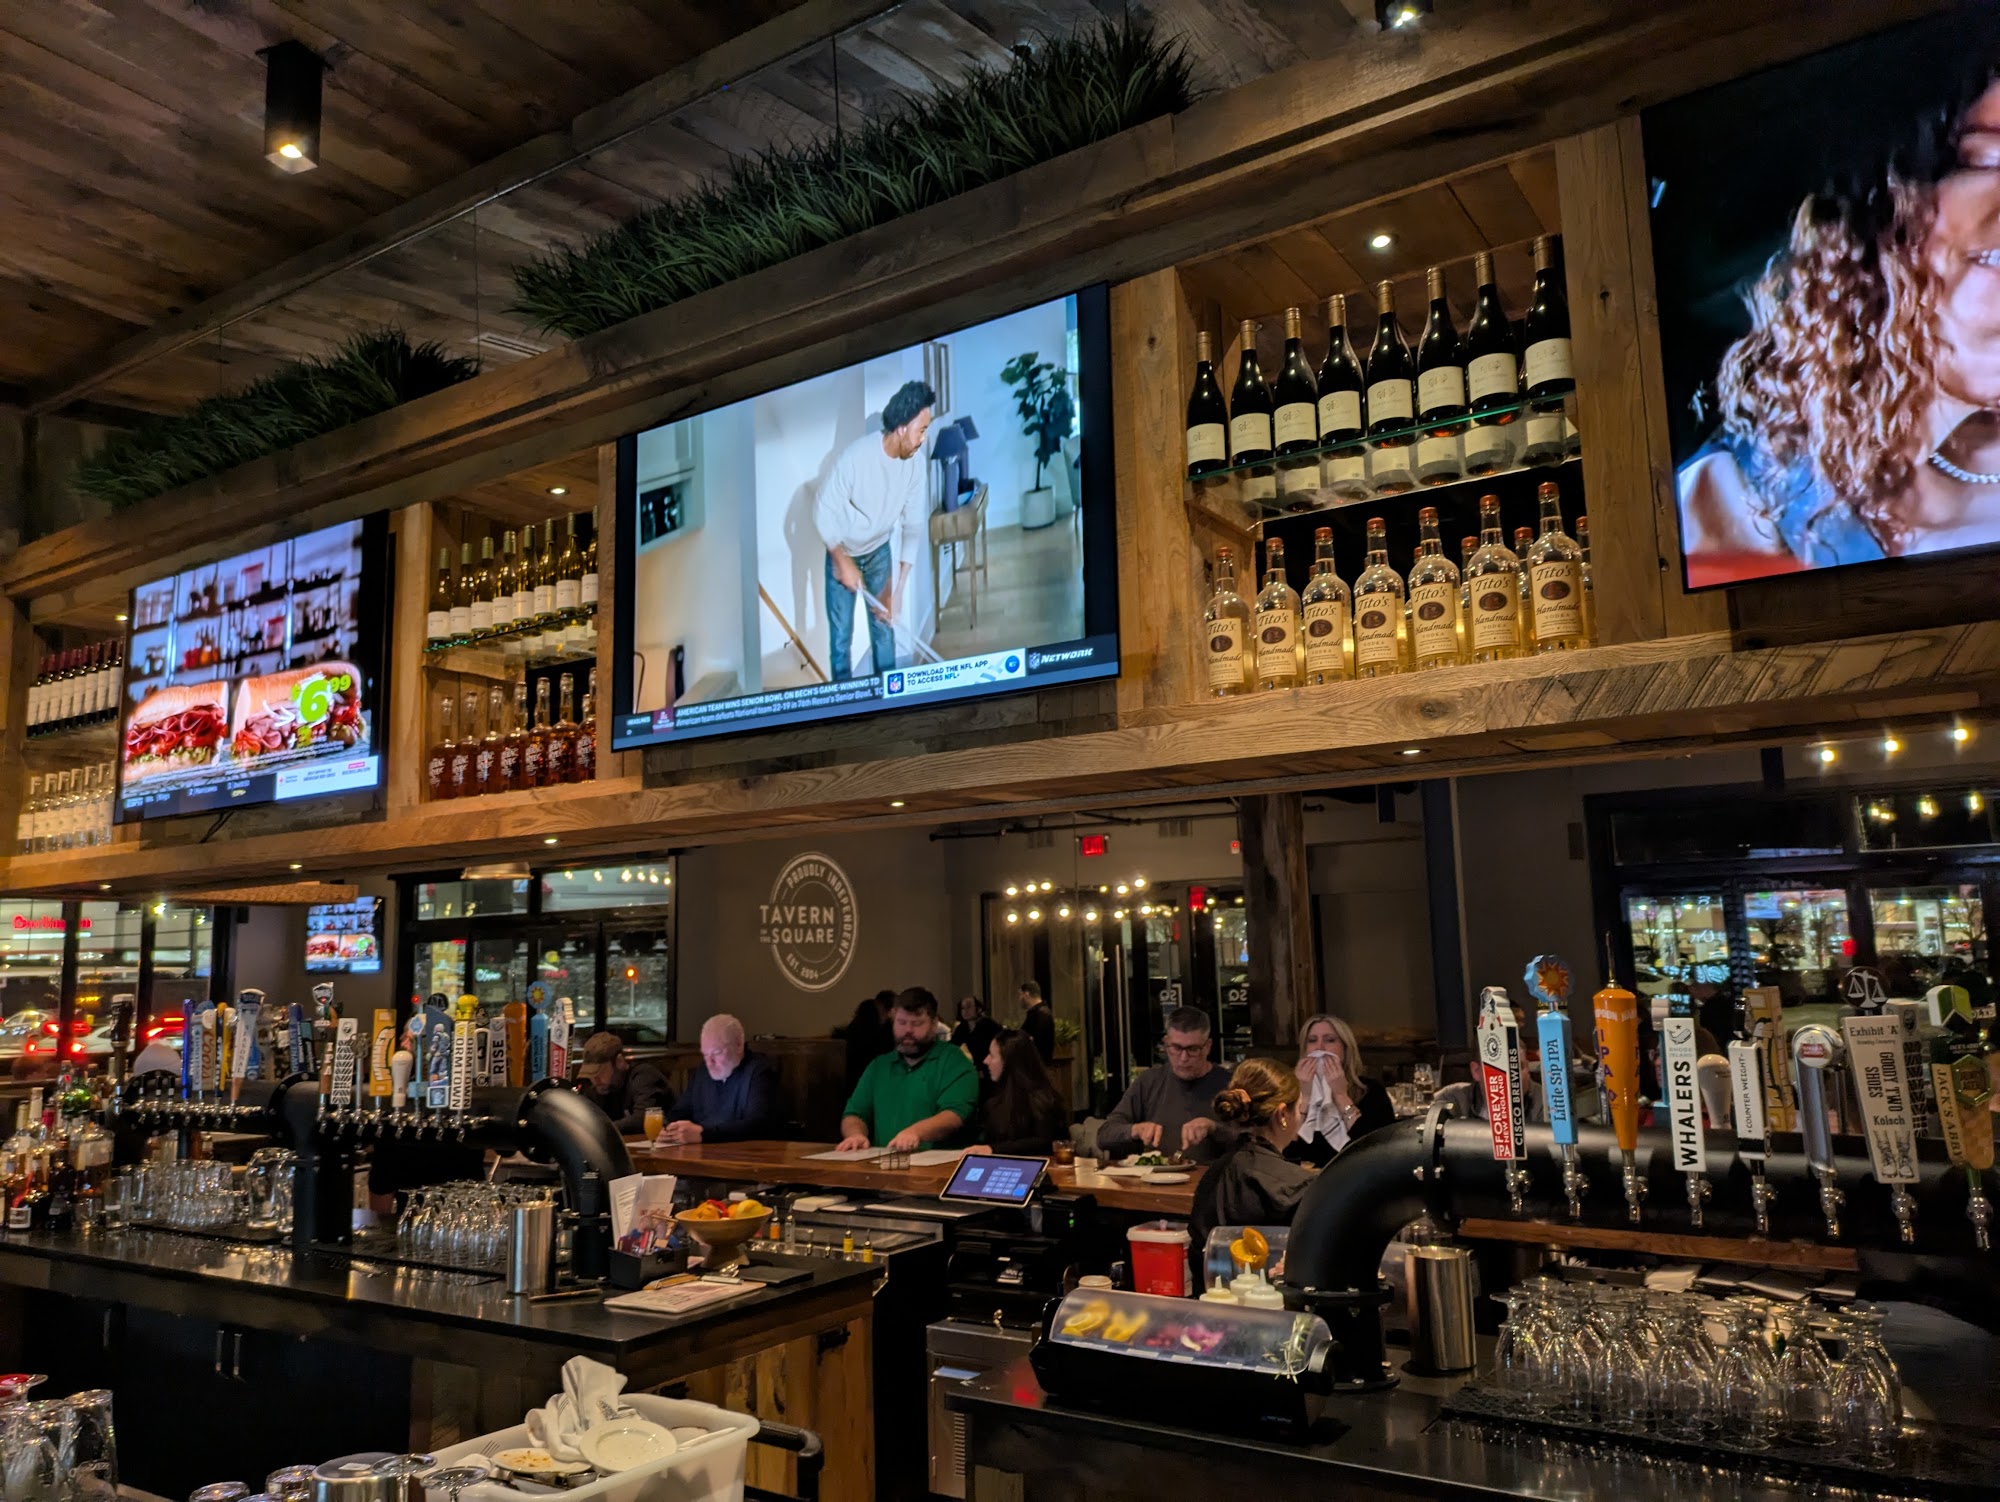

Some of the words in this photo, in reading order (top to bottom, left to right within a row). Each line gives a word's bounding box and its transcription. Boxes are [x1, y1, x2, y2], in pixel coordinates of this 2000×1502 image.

[1476, 577, 1510, 592] Tito's
[1537, 565, 1572, 582] Tito's
[1358, 596, 1390, 611] Tito's
[1415, 586, 1448, 602] Tito's
[1259, 612, 1288, 626] Tito's
[1306, 606, 1336, 620] Tito's
[1208, 622, 1236, 635] Tito's
[1041, 648, 1094, 664] NETWORK
[907, 666, 944, 679] DOWNLOAD
[946, 664, 958, 673] THE
[960, 662, 974, 671] NFL
[975, 660, 988, 669] APP
[918, 675, 943, 684] ACCESS
[676, 706, 706, 717] AMERICAN
[708, 702, 724, 712] TEAM
[726, 701, 740, 710] WINS
[741, 696, 764, 706] SENIOR
[765, 694, 783, 703] BOWL
[795, 688, 818, 698] BECH'S
[820, 680, 868, 694] GAME-WINNING
[870, 678, 880, 686] TD
[676, 717, 701, 727] American
[702, 716, 714, 724] team
[716, 712, 734, 721] defeats
[735, 707, 758, 718] National
[772, 702, 790, 712] 22-19
[836, 692, 854, 702] Senior
[786, 864, 826, 888] PROUDLY
[760, 906, 834, 924] TAVERN
[827, 872, 852, 958] INDEPENDENT
[772, 928, 834, 944] SQUARE
[1849, 1026, 1884, 1036] Exhibit
[493, 1040, 504, 1074] RISE
[1547, 1038, 1560, 1062] IPA
[452, 1024, 464, 1108] WORMTOWN
[1509, 1048, 1520, 1102] BREWERS
[1548, 1066, 1563, 1086] Sip
[1739, 1058, 1749, 1092] WEIGHT
[1880, 1052, 1898, 1086] GOODY
[1865, 1066, 1883, 1098] SHOES
[1489, 1075, 1503, 1143] FOREVER
[1498, 1075, 1508, 1120] ENGLAND
[1550, 1088, 1566, 1122] Little
[1886, 1087, 1904, 1112] TWO
[1674, 1061, 1698, 1166] WHALERS
[1744, 1094, 1753, 1128] COUNTER
[1936, 1069, 1954, 1118] JACK'S
[1946, 1122, 1963, 1160] ABBY
[1514, 1106, 1523, 1146] CISCO
[1496, 1144, 1512, 1157] IPA
